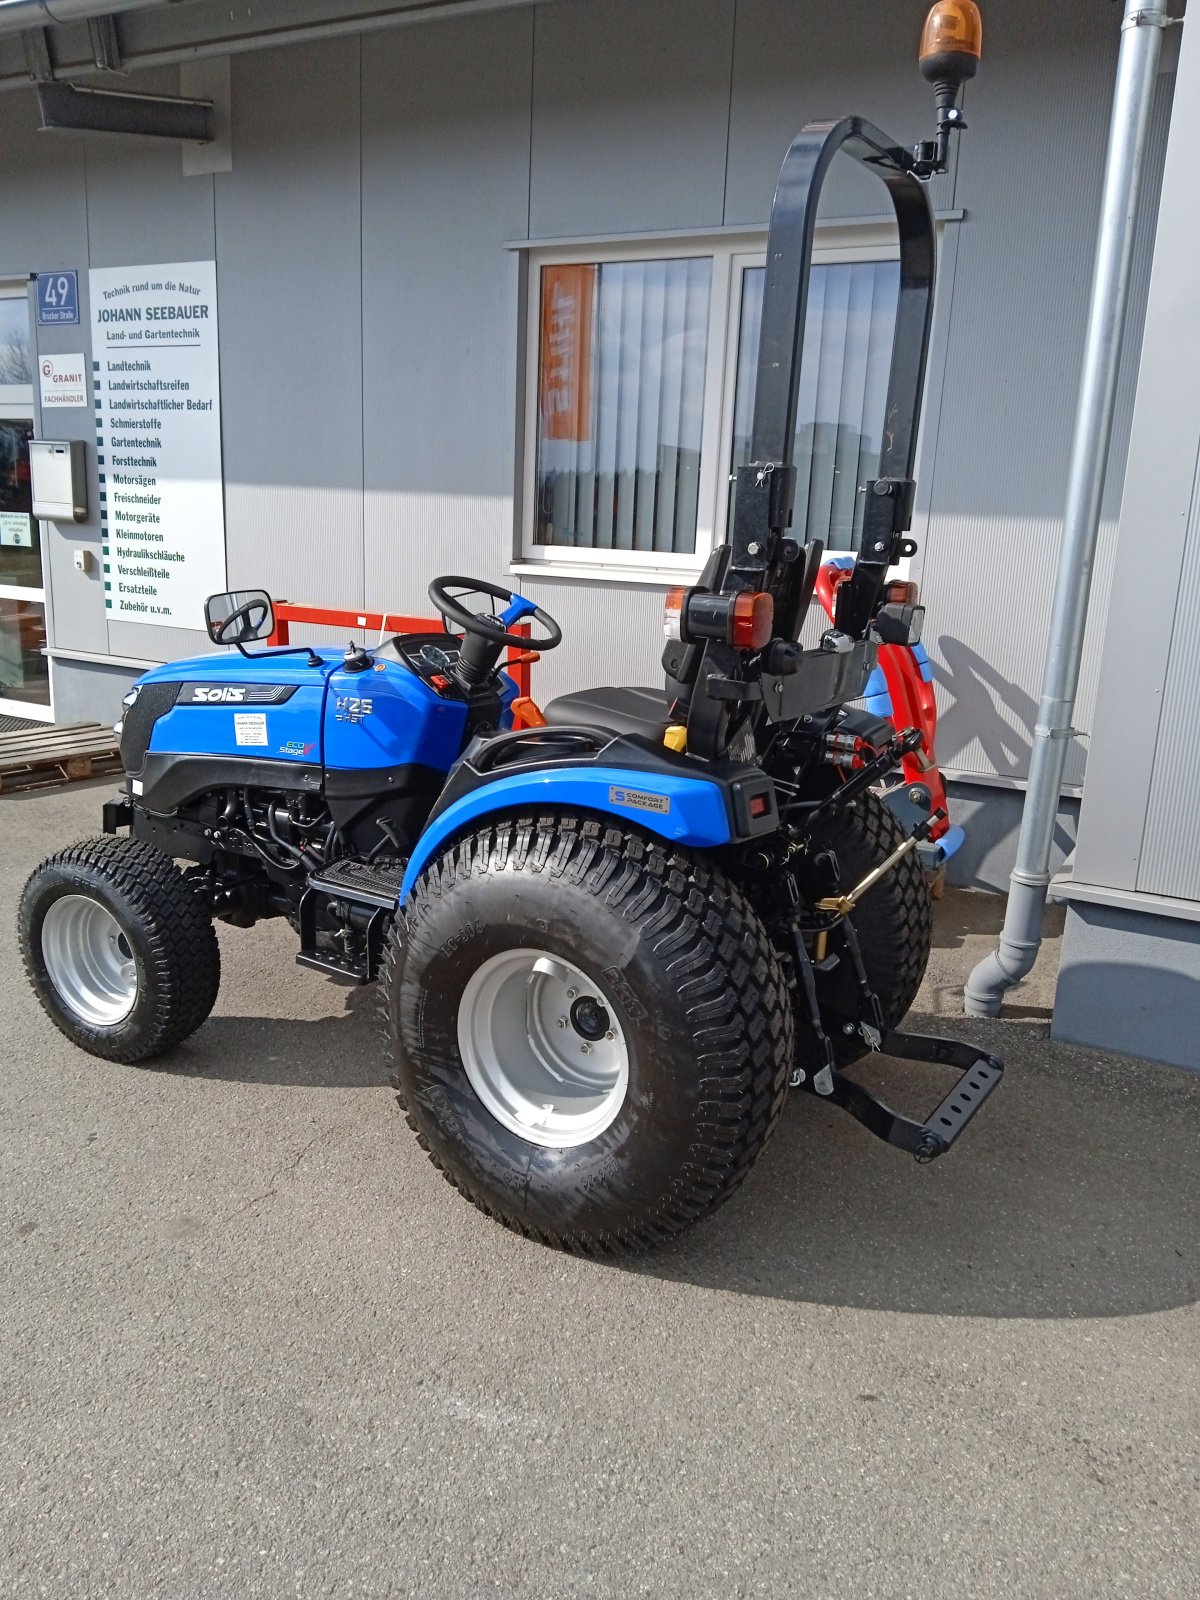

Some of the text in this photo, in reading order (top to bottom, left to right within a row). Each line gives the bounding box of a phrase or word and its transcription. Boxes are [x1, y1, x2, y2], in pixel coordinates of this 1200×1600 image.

[45, 276, 68, 306] 49
[103, 281, 201, 300] Technik rund um die Natur
[97, 304, 209, 323] JOHANN SEEBAUER
[106, 328, 200, 341] Land- und Gartentechnik
[107, 360, 151, 371] Landtechnik
[52, 374, 82, 383] GRANIT
[108, 379, 190, 391] Landwirtschaftsreifen
[44, 394, 84, 403] FACHHÄNDLER
[109, 399, 213, 411] Landwirtschaftlicher Bedarf
[110, 418, 162, 429] Schmierstoffe
[111, 436, 162, 448] Gartentechnik
[112, 455, 157, 467] Forsttechnik
[113, 473, 156, 487] Motorsägen
[114, 492, 162, 505] Freischneider
[115, 510, 160, 524] Motorgeräte
[116, 529, 164, 542] Kleinmotoren
[117, 546, 185, 562] Hydraulikschläuche
[117, 564, 170, 579] Verschleißteile
[118, 582, 157, 596] Ersatzteile
[119, 600, 172, 615] Zubehör u.v.m.
[336, 696, 373, 714] H26
[626, 792, 664, 804] COMFORT
[626, 798, 663, 809] PACKAGE
